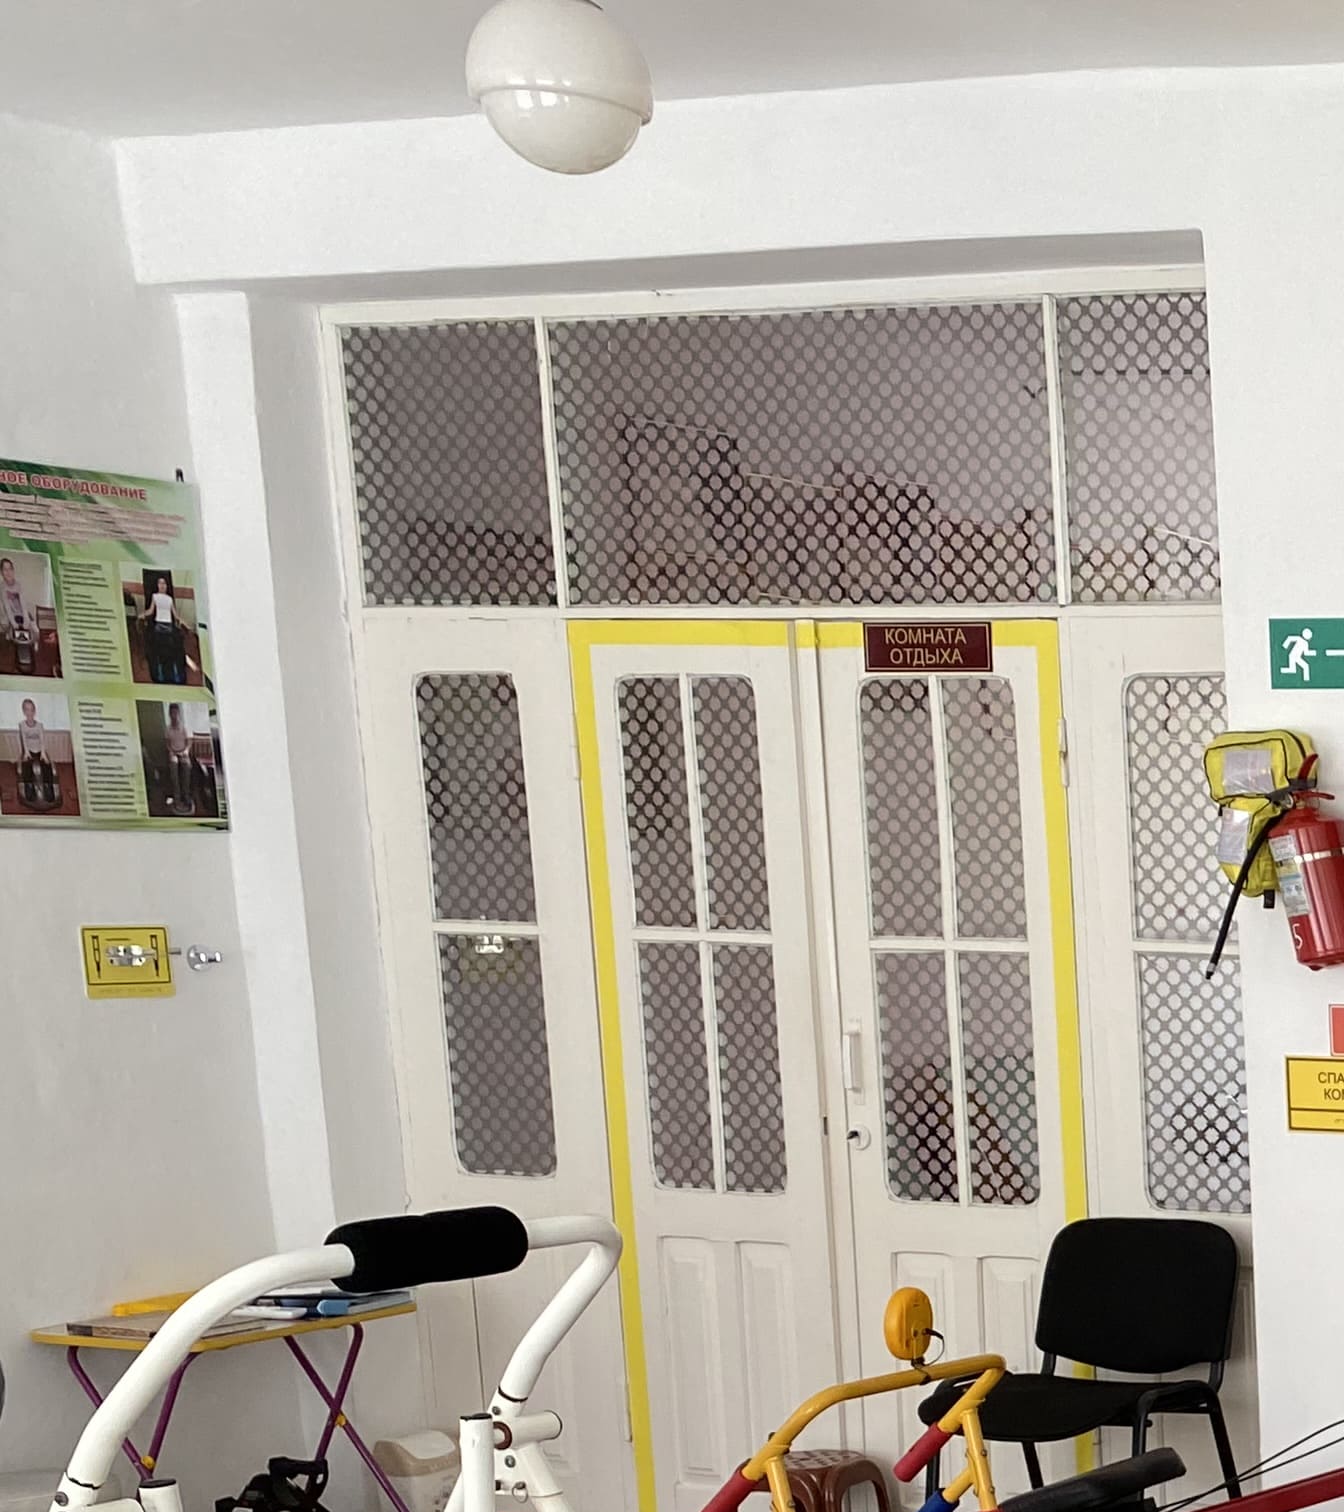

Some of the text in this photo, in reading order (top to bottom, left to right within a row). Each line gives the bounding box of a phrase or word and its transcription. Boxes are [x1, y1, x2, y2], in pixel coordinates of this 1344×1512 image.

[31, 475, 148, 501] ОБОРУДОВАНИЕ
[885, 628, 967, 645] КОМНАТА
[890, 648, 964, 667] ОТДЫХА
